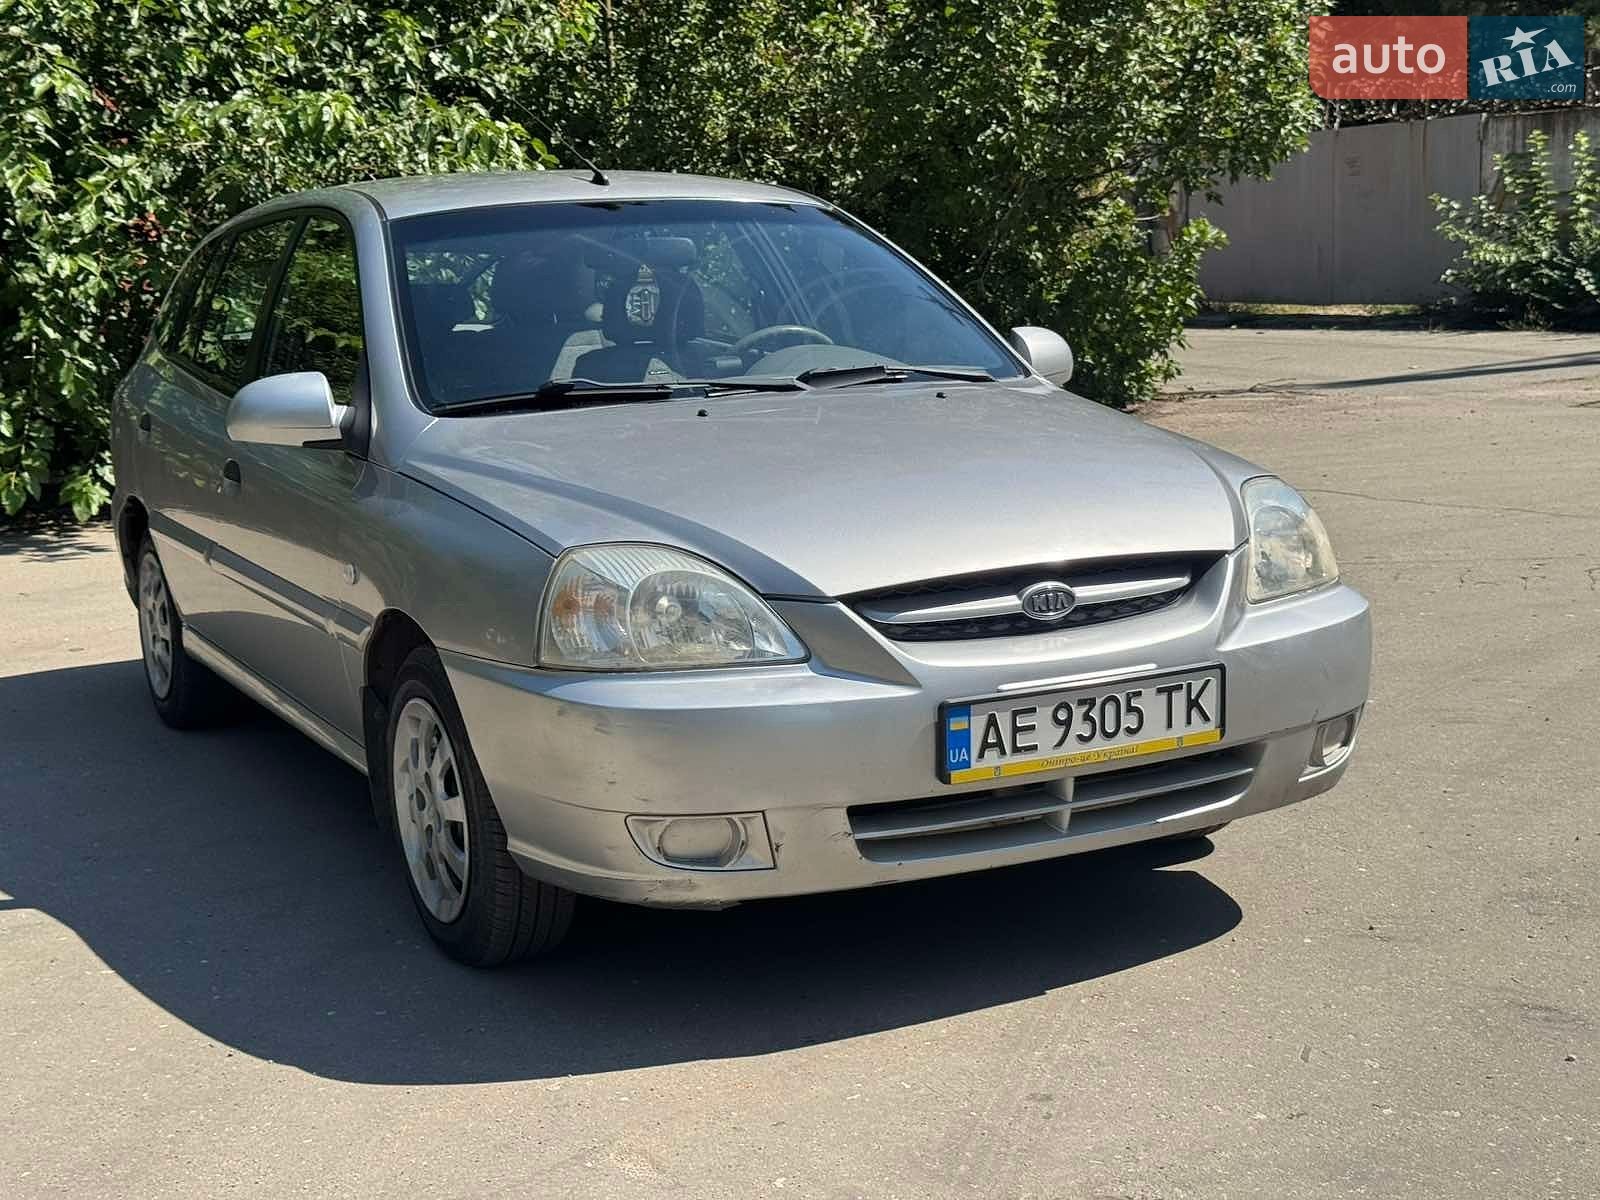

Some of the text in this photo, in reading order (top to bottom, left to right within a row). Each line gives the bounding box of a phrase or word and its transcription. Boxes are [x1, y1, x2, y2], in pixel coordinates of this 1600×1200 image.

[1032, 591, 1071, 612] KIA
[977, 678, 1215, 762] AE 9305 TK
[949, 747, 969, 763] UA
